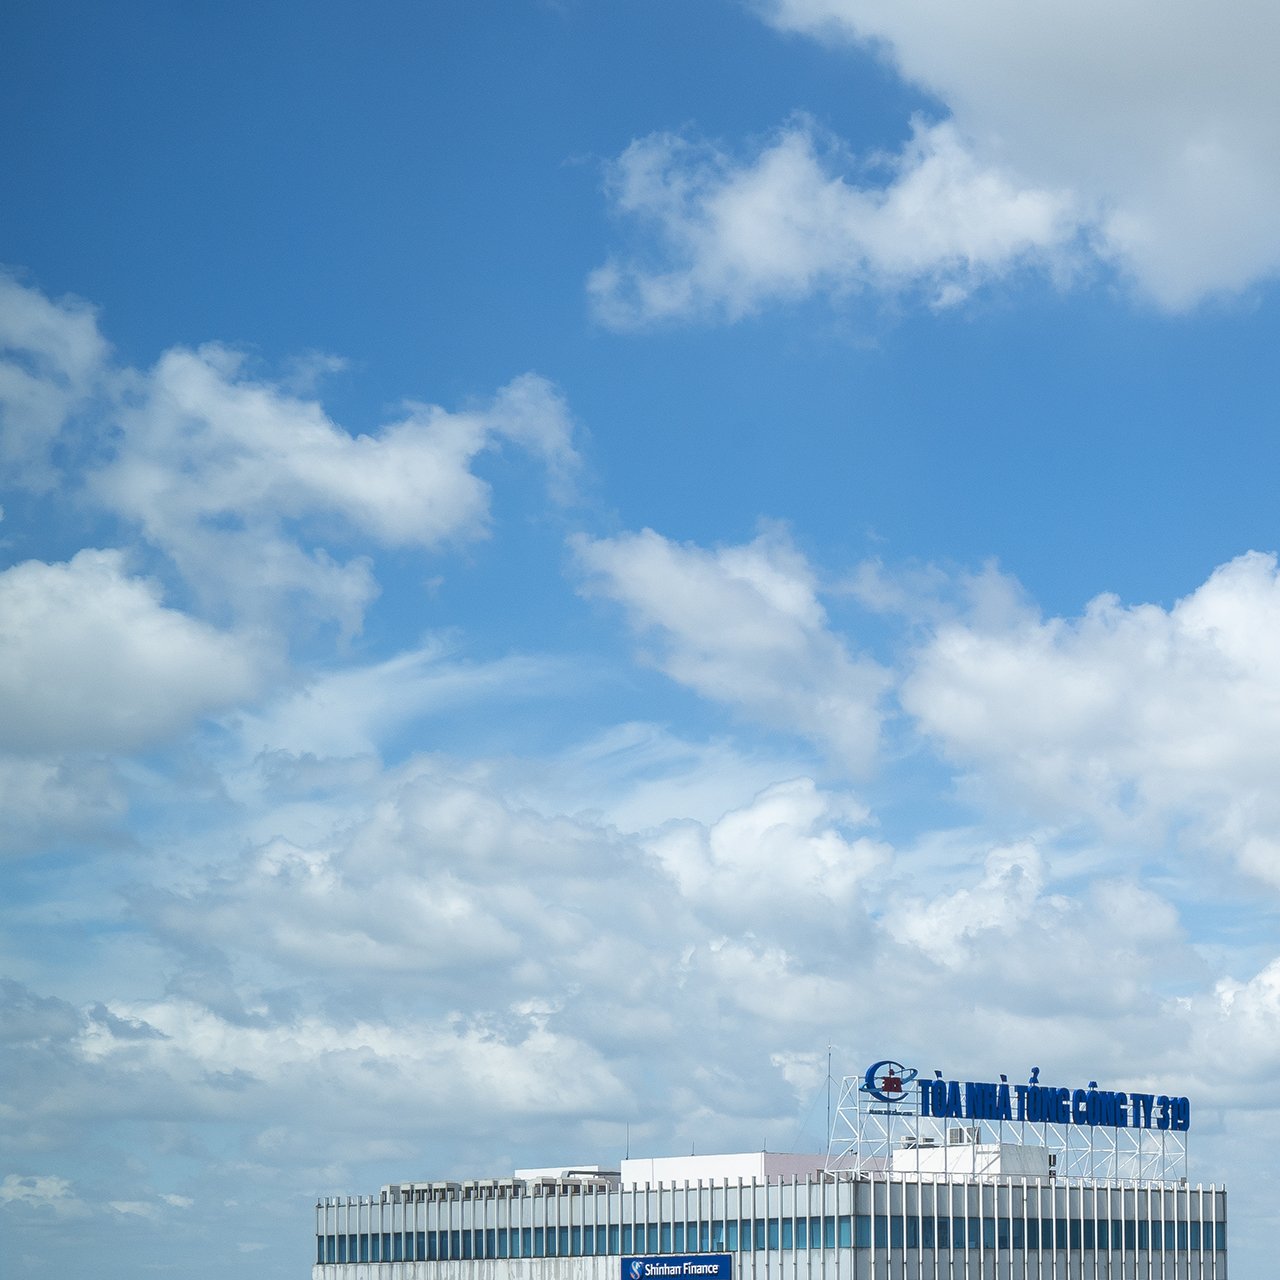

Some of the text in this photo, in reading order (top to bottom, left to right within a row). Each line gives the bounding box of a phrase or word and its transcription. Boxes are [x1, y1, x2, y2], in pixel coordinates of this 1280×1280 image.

[918, 1065, 1190, 1131] TÒA NHÀ TỔNG CÔNG TY 319
[644, 1261, 719, 1276] Shinhan Finance
